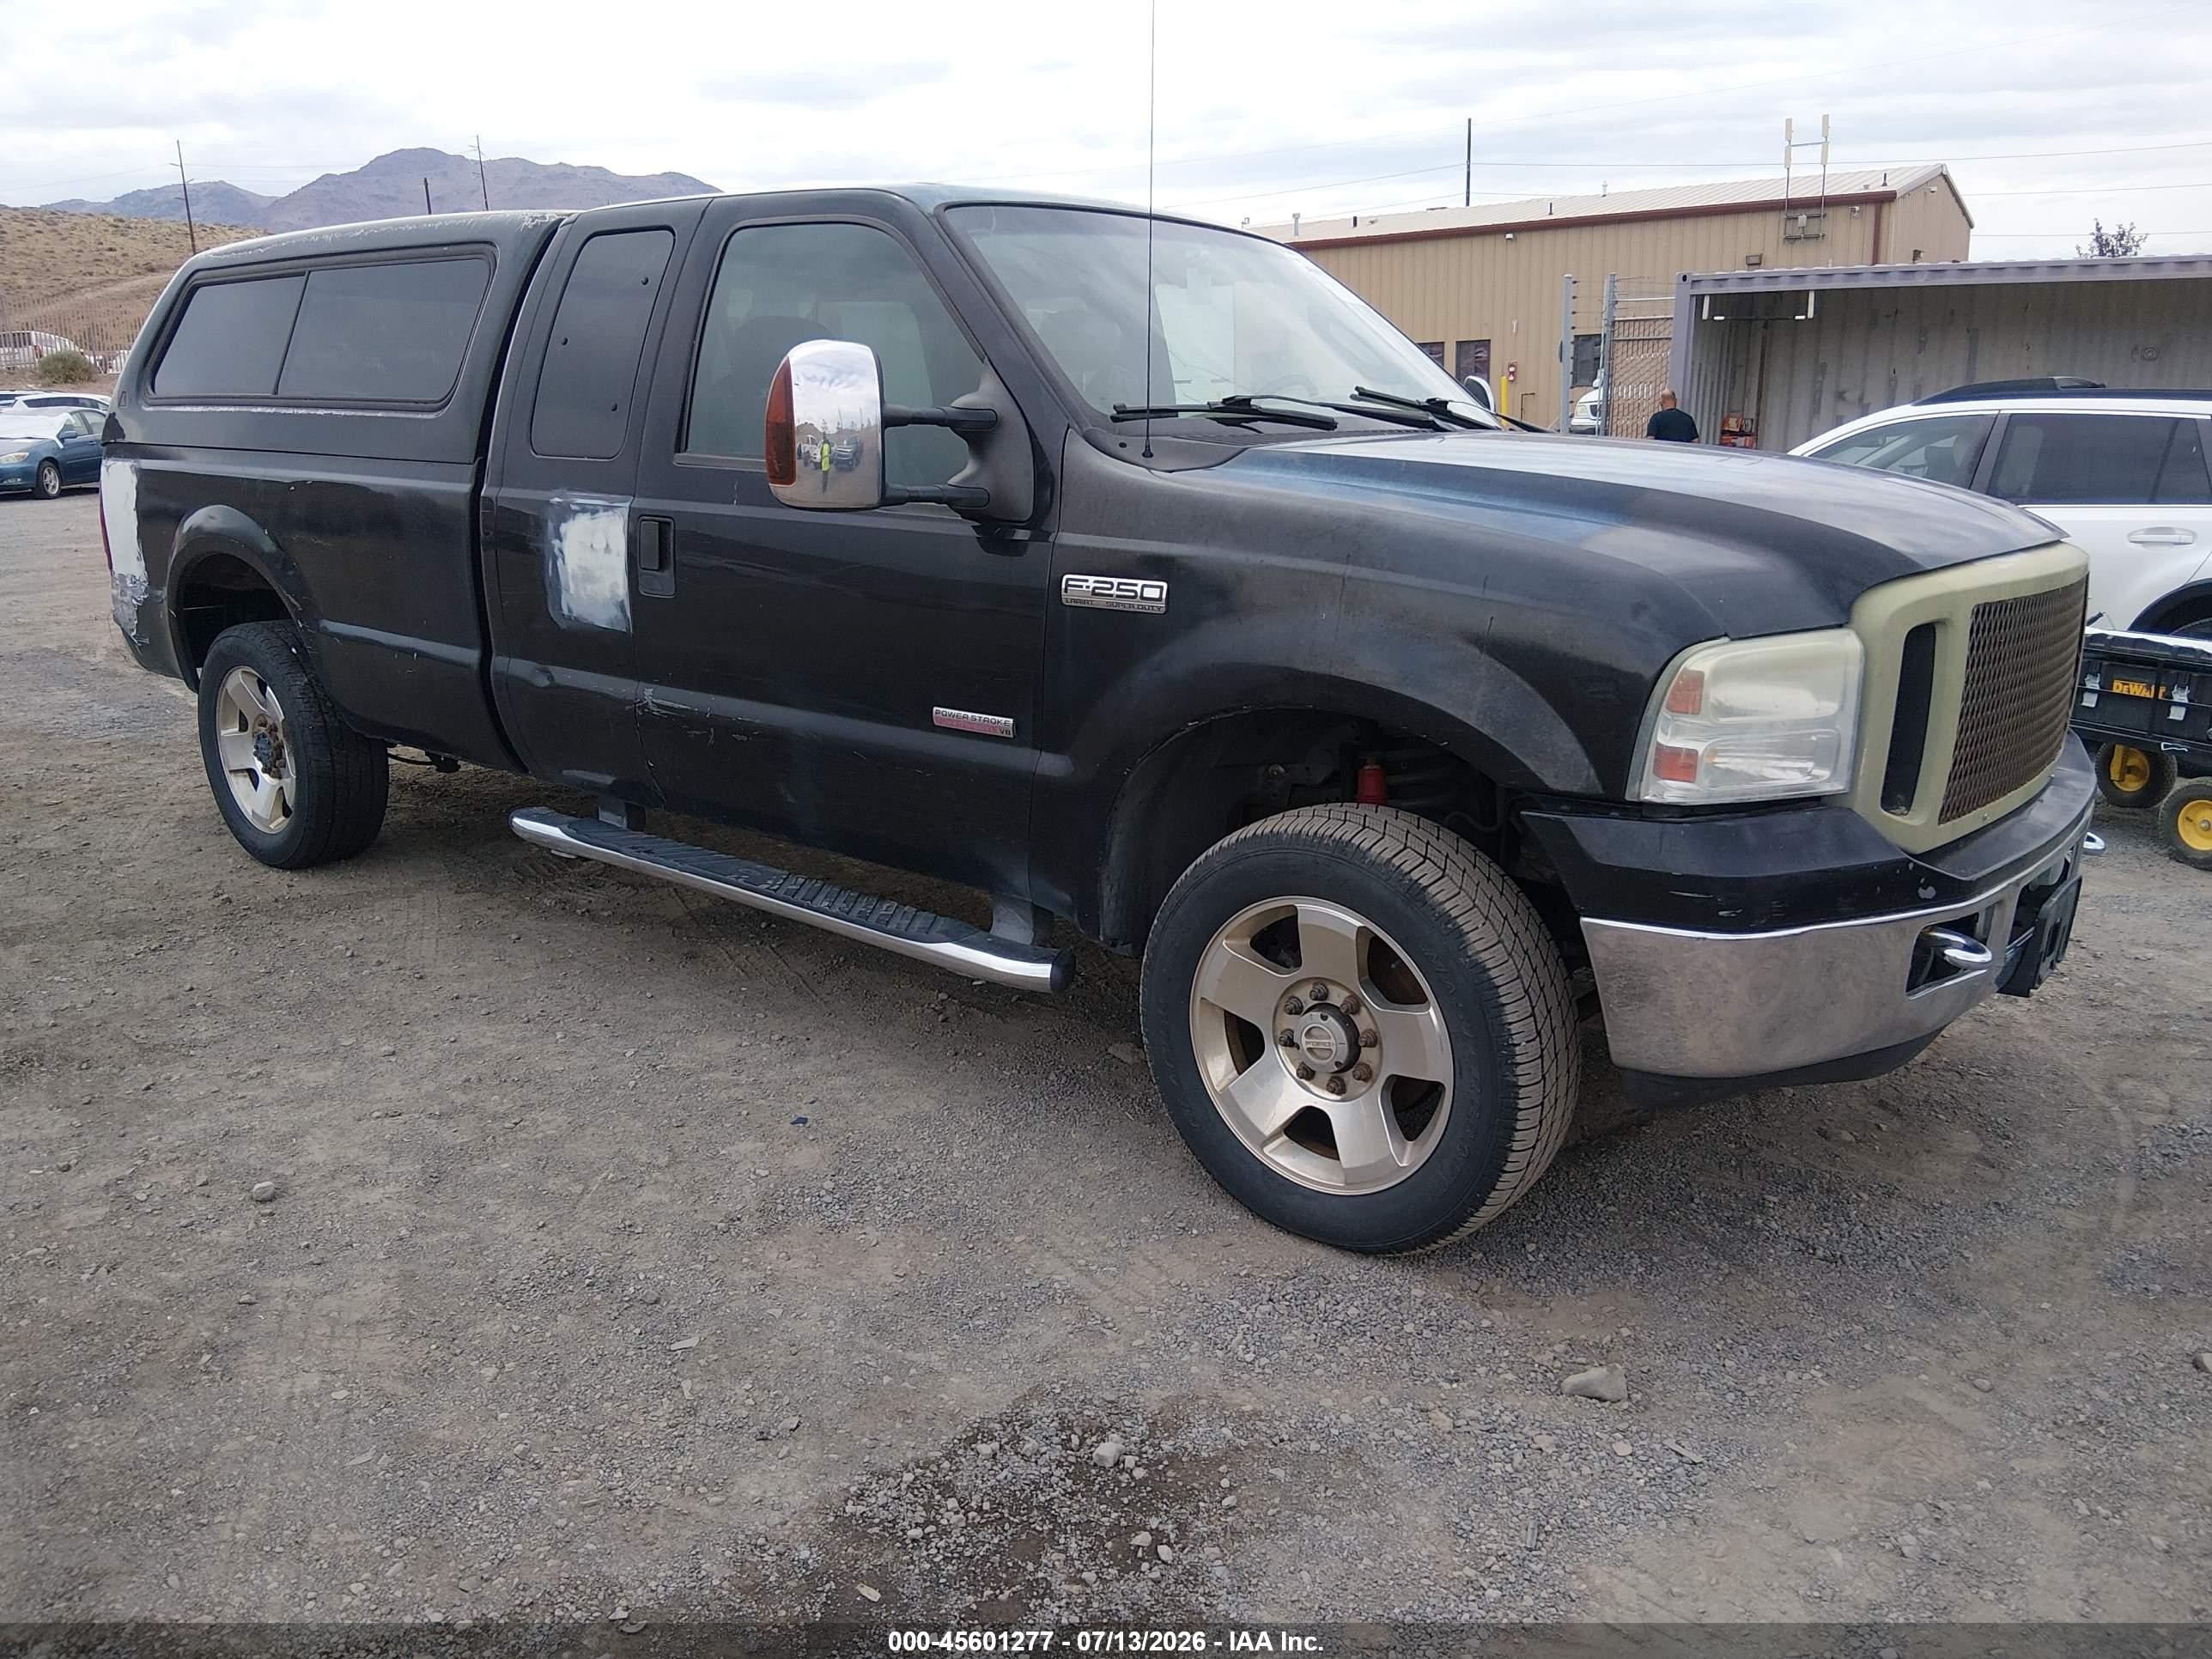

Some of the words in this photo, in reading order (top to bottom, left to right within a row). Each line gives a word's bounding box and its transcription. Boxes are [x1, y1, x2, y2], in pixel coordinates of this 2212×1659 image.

[1064, 577, 1164, 602] F-250
[1105, 601, 1135, 610] SUPER
[934, 708, 969, 720] POWER
[970, 714, 1012, 727] STROKE
